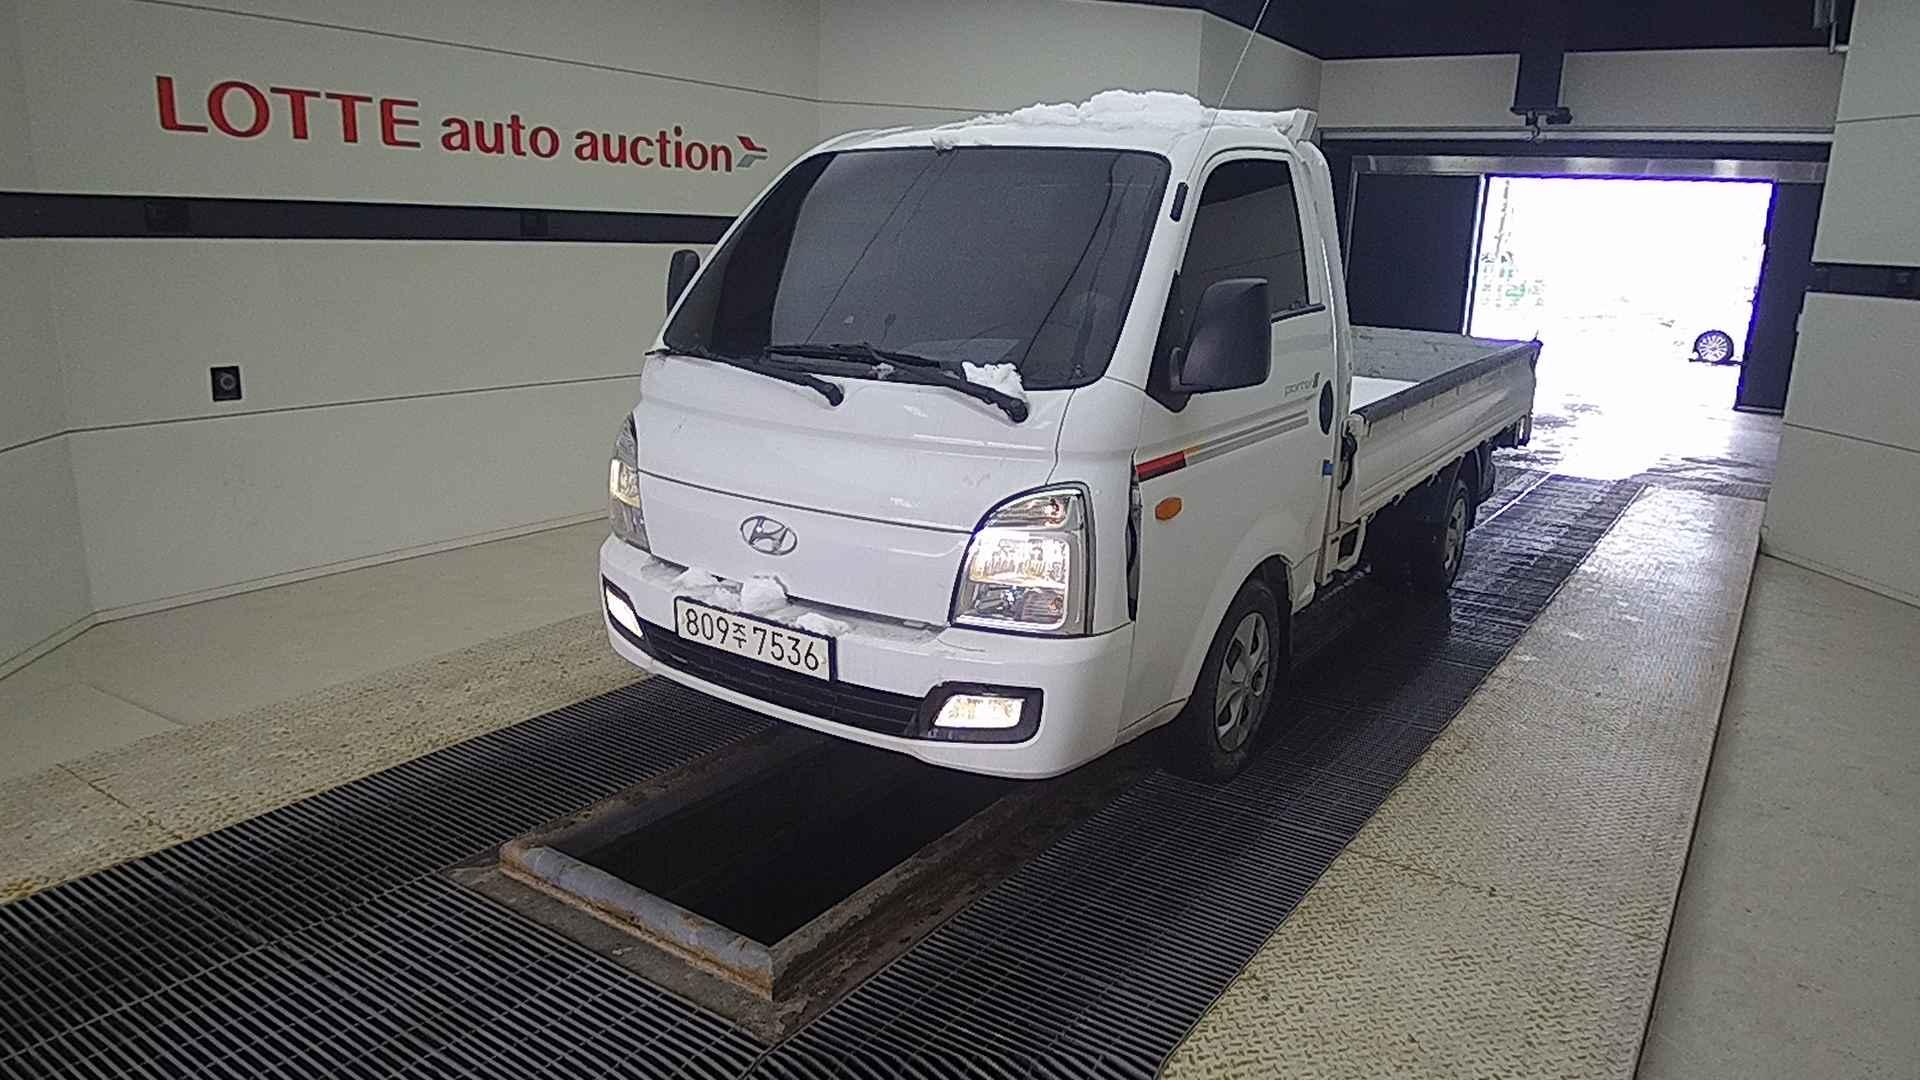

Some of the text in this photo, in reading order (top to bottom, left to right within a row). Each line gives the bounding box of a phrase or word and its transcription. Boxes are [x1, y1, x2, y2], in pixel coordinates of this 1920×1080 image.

[155, 75, 733, 171] LOTTE auto auction
